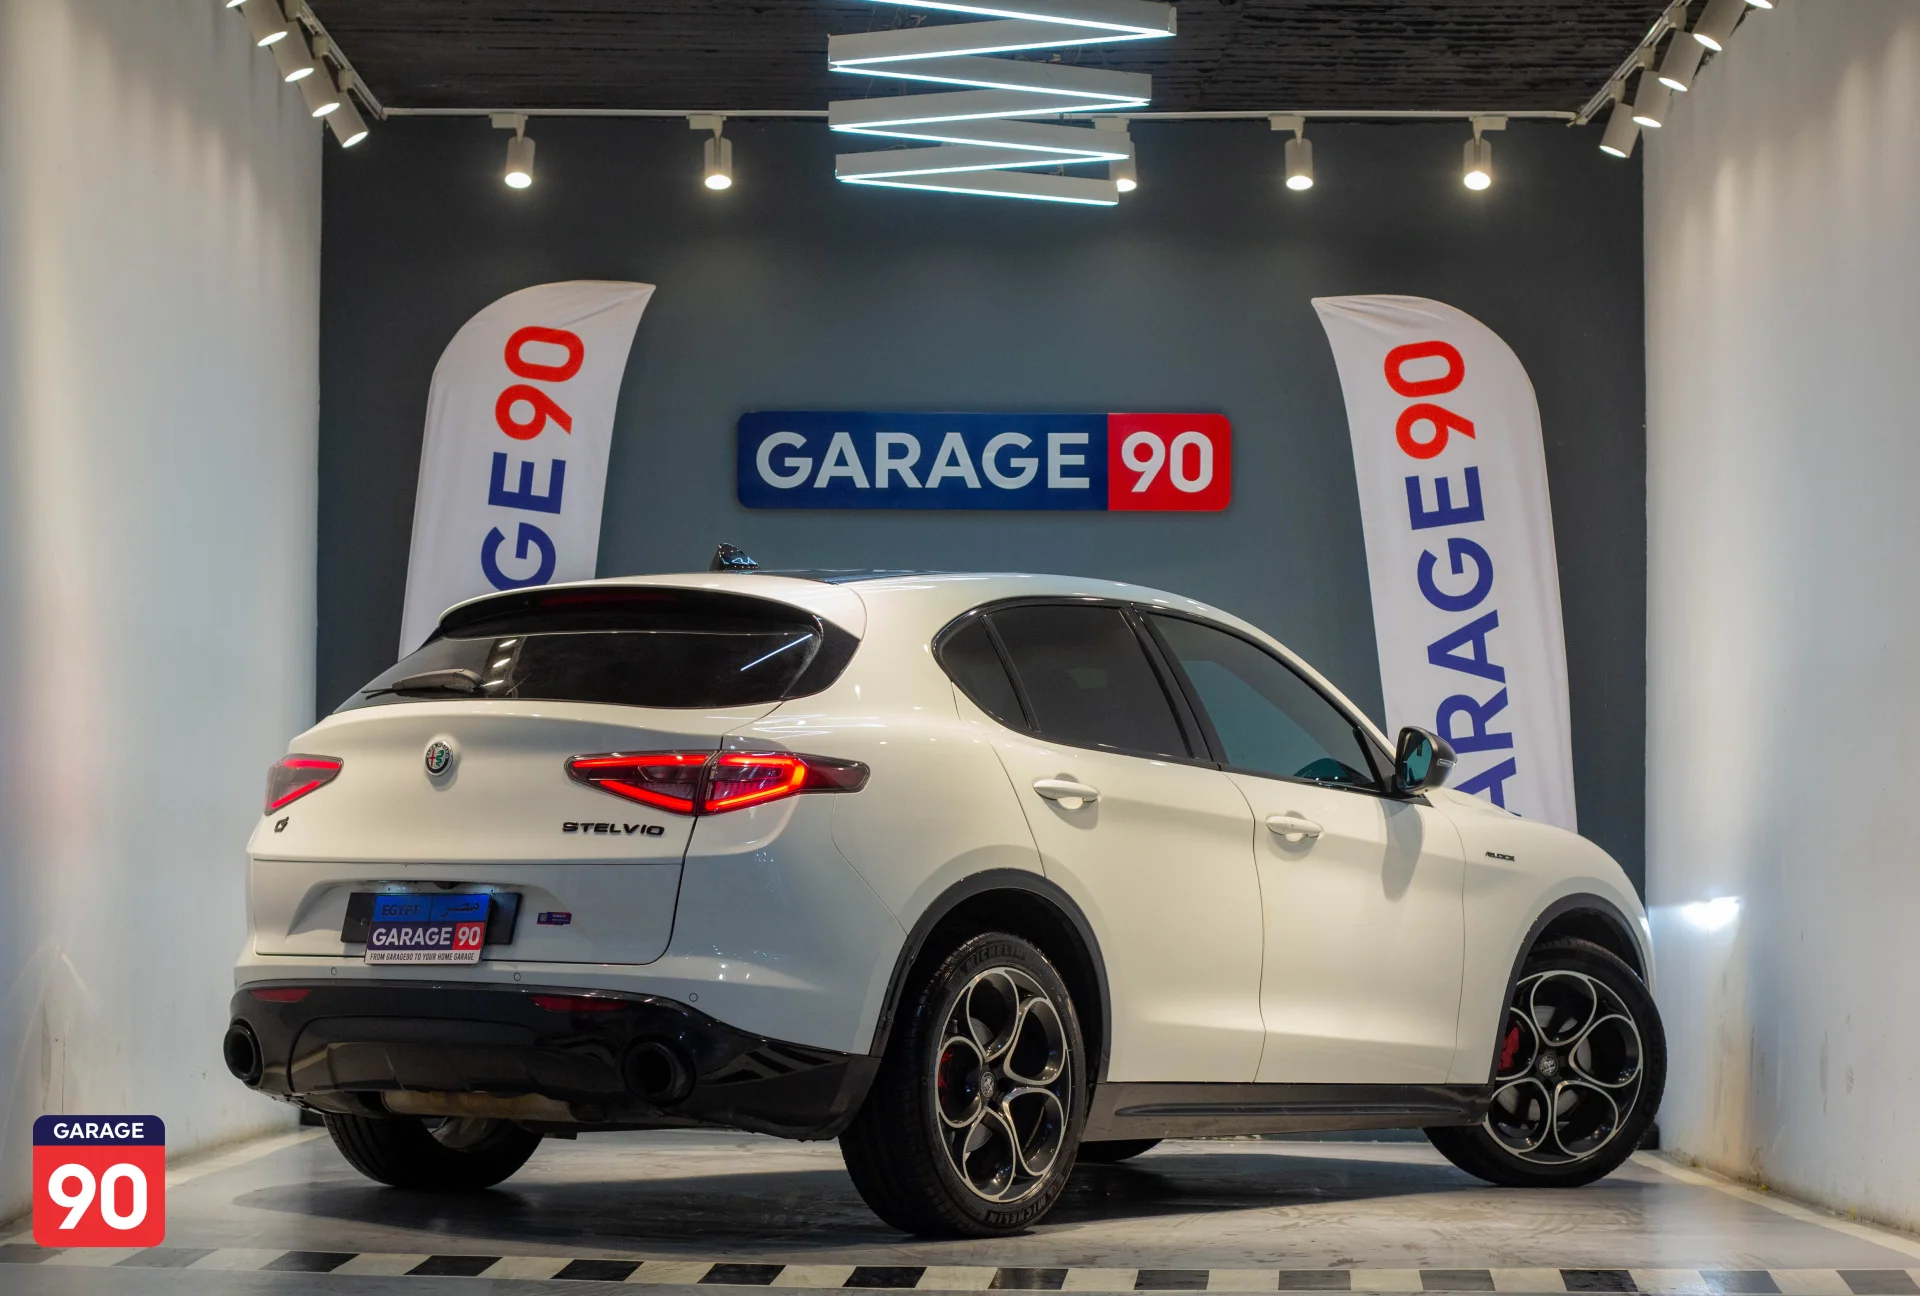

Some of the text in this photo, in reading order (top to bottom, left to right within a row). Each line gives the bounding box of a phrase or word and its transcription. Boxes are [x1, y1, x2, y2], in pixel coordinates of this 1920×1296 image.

[756, 431, 1213, 493] GARAGE 90
[562, 822, 665, 836] STELVIO
[382, 904, 419, 917] EGYPT
[441, 902, 480, 917] مصر
[372, 926, 481, 946] GARAGE 90
[370, 953, 386, 961] FROM
[414, 953, 421, 961] TO
[423, 953, 437, 961] YOUR
[437, 953, 453, 961] HOME
[453, 953, 475, 961] GARAGE
